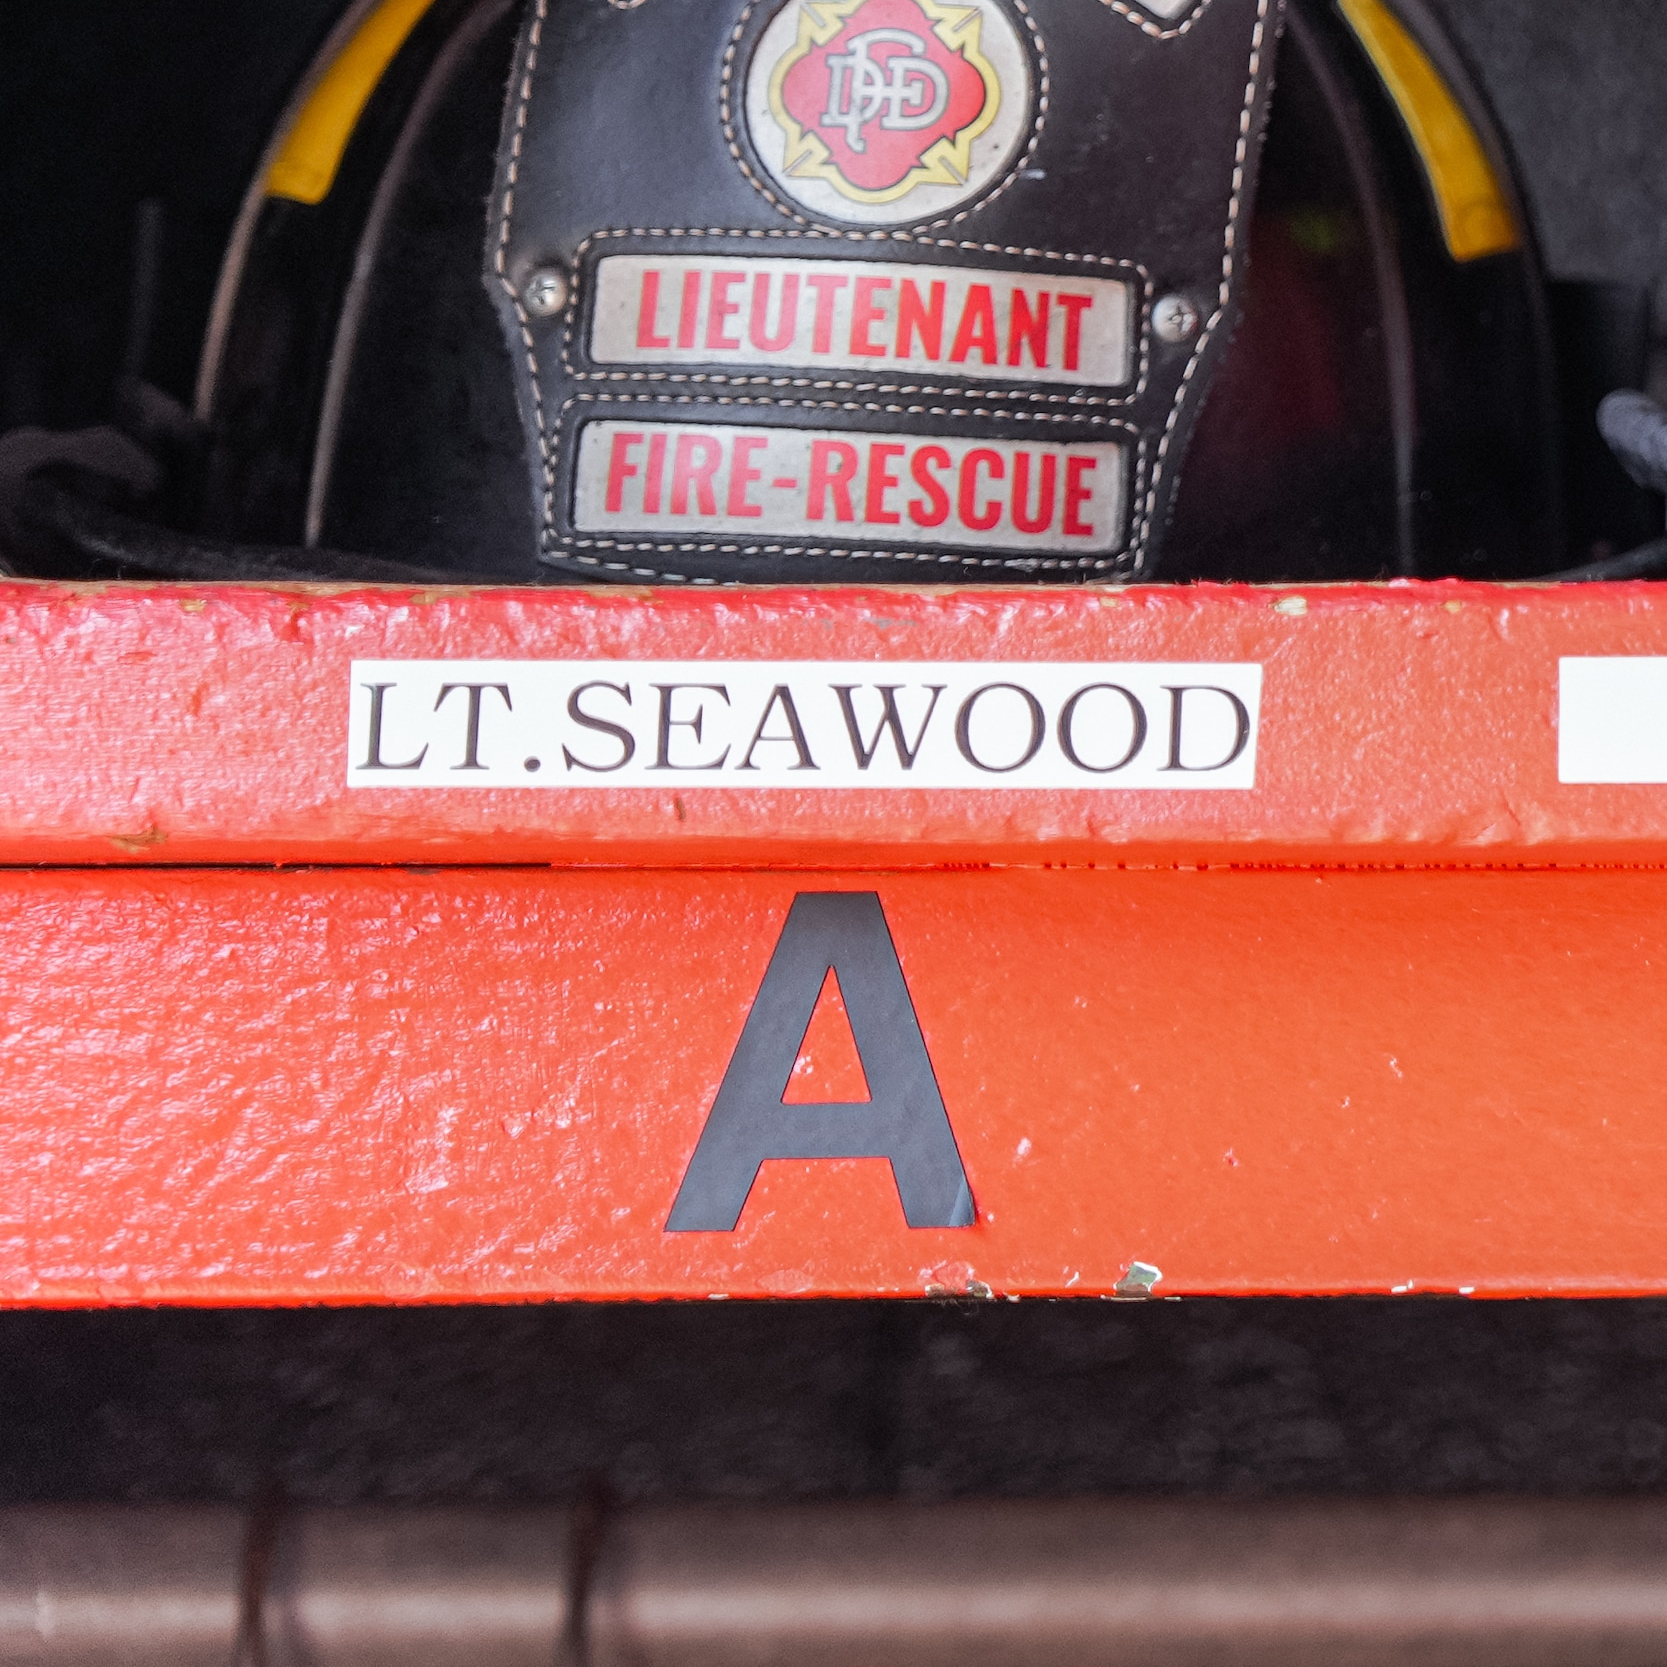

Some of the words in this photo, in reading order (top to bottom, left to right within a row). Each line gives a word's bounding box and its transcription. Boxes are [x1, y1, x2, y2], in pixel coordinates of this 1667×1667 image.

[636, 269, 1093, 371] LIEUTENANT
[604, 431, 1097, 537] FIRE-RESCUE
[664, 890, 977, 1233] A
